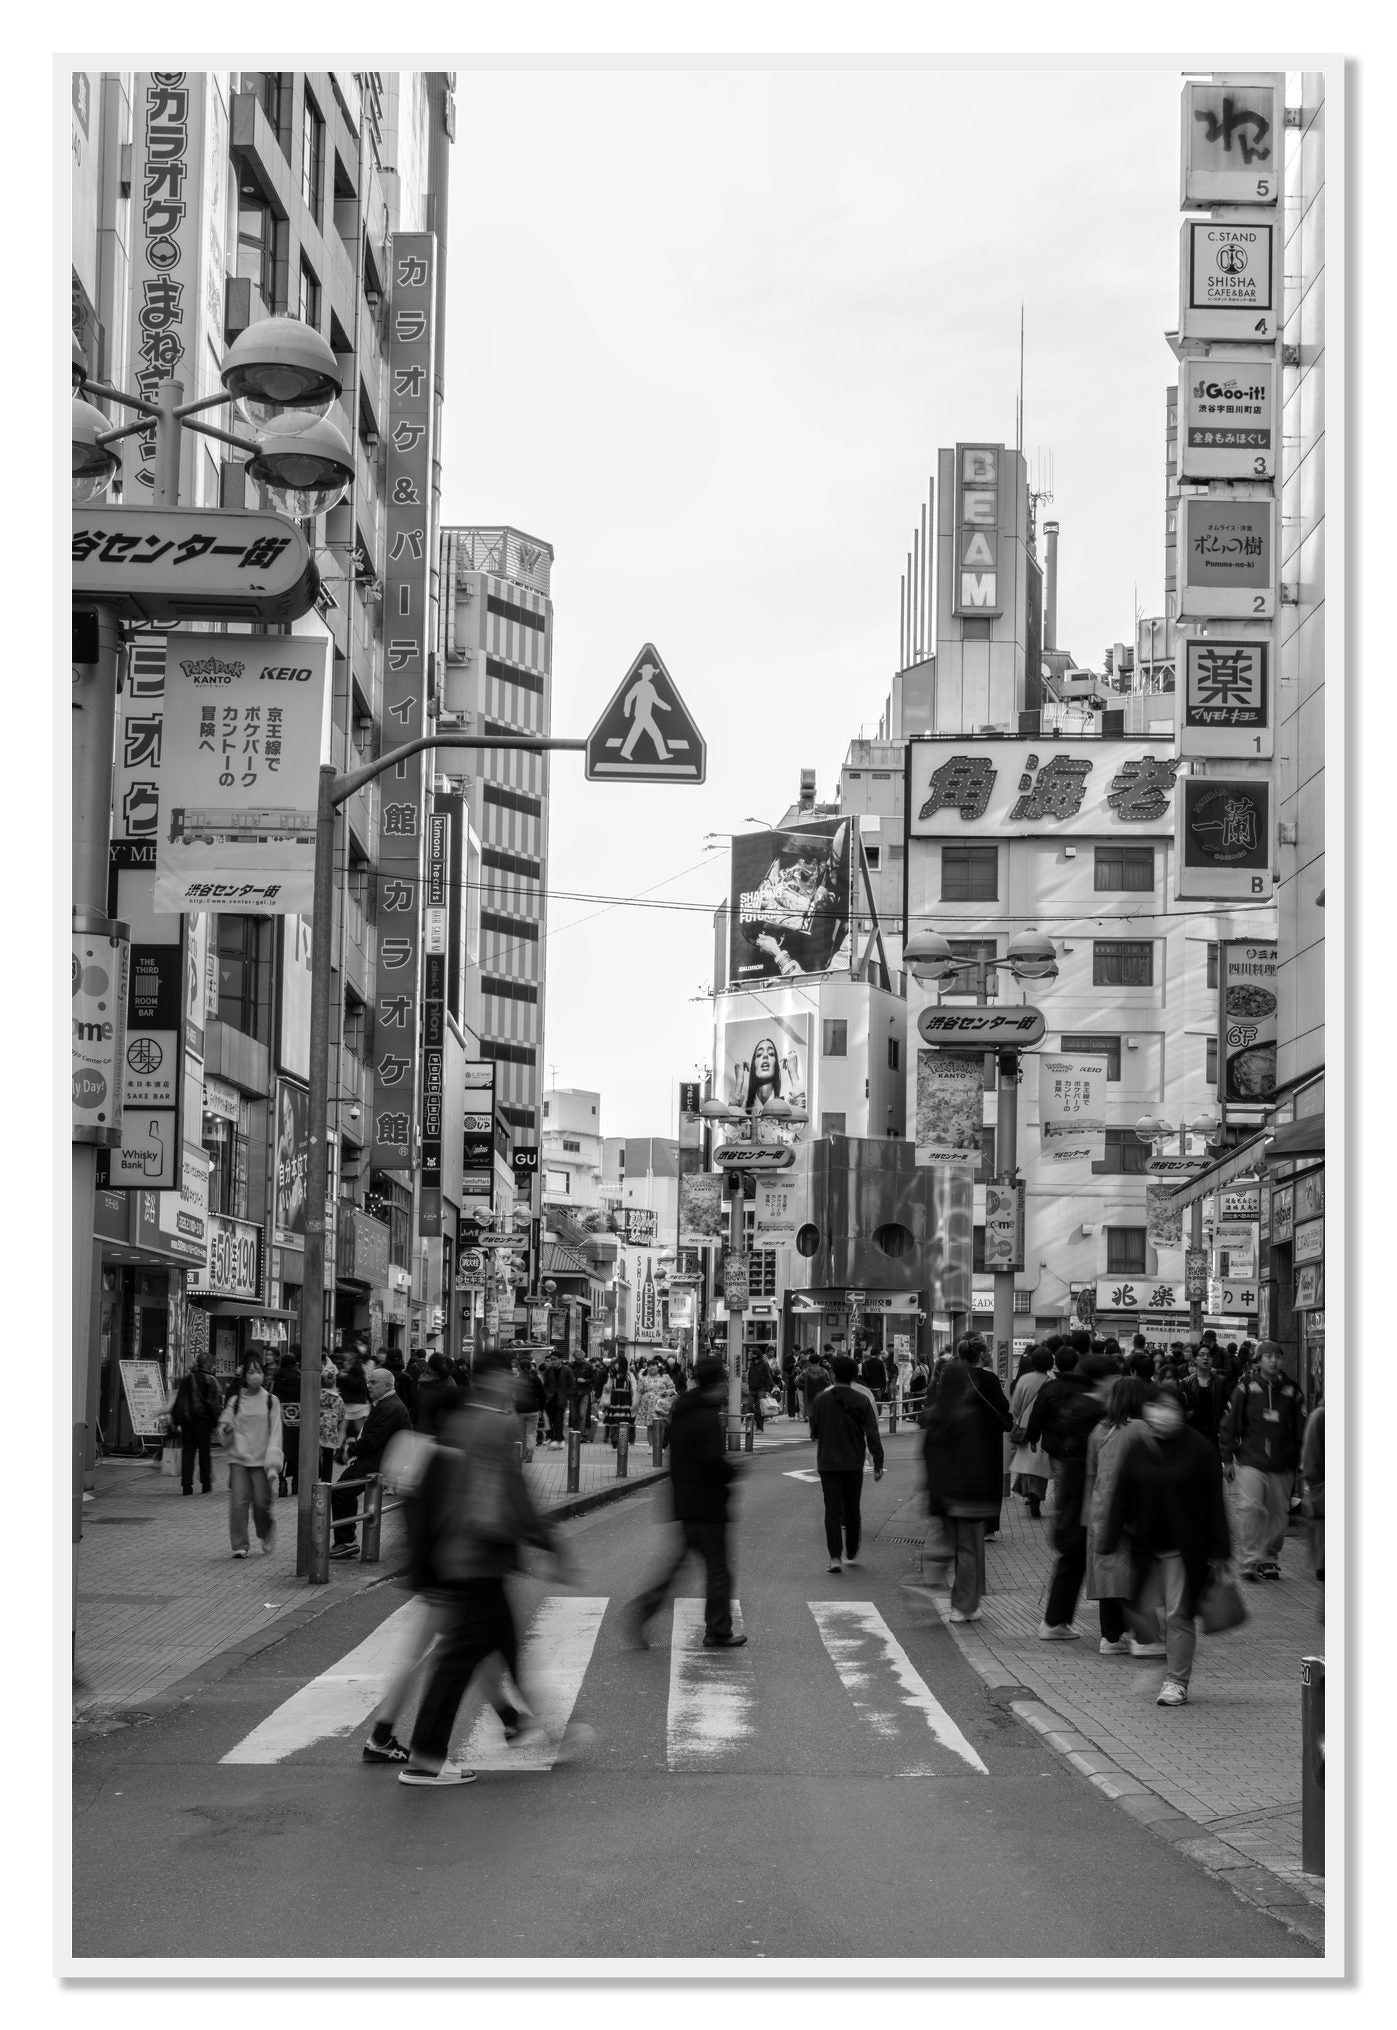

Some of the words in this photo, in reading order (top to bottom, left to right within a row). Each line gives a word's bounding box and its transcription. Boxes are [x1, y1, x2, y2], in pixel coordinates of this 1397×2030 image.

[145, 86, 189, 238] カラオケ
[1256, 179, 1269, 196] 5
[1207, 231, 1257, 242] C.STAND
[1207, 276, 1256, 288] SHISHA
[1207, 288, 1256, 298] CAFE&BAR
[1254, 318, 1267, 335] 4
[1205, 382, 1266, 401] Goo-it!
[1198, 404, 1262, 415] 渋谷宇田川町店
[1193, 432, 1267, 445] 全身もみほぐし
[1253, 457, 1267, 475] 3
[961, 447, 998, 607] BEAM
[1193, 534, 1264, 556] ポムの樹
[1253, 596, 1266, 613] 2
[193, 675, 232, 684] KANTO
[259, 666, 312, 682] KEIO
[1198, 649, 1252, 704] 薬
[1191, 707, 1258, 724] マツモトキヨシ
[124, 617, 178, 837] ラオケ
[198, 705, 217, 753] 冒険へ
[219, 706, 239, 788] カントーの
[241, 705, 261, 788] ポケパーク
[265, 706, 284, 773] 京王線で
[1253, 736, 1261, 753] 1
[1192, 797, 1257, 850] 一蘭
[433, 820, 443, 858] kimono
[184, 883, 282, 898] 渋谷センター街
[432, 864, 442, 901] hearts
[1251, 877, 1264, 893] B
[136, 966, 159, 974] THIRD
[135, 997, 158, 1005] ROOM
[138, 1009, 154, 1017] BAR
[376, 880, 413, 1146] カラオケ館
[926, 1015, 1038, 1030] 渋谷センター街
[1226, 1026, 1258, 1047] 6F
[477, 1122, 490, 1130] UP
[122, 1150, 158, 1162] Whisky
[515, 1154, 537, 1165] GU
[718, 1151, 785, 1160] 渋谷センター街
[121, 1160, 143, 1169] Bank
[96, 1172, 108, 1183] 1F
[1111, 1284, 1176, 1307] 兆楽
[644, 1282, 654, 1328] BEER
